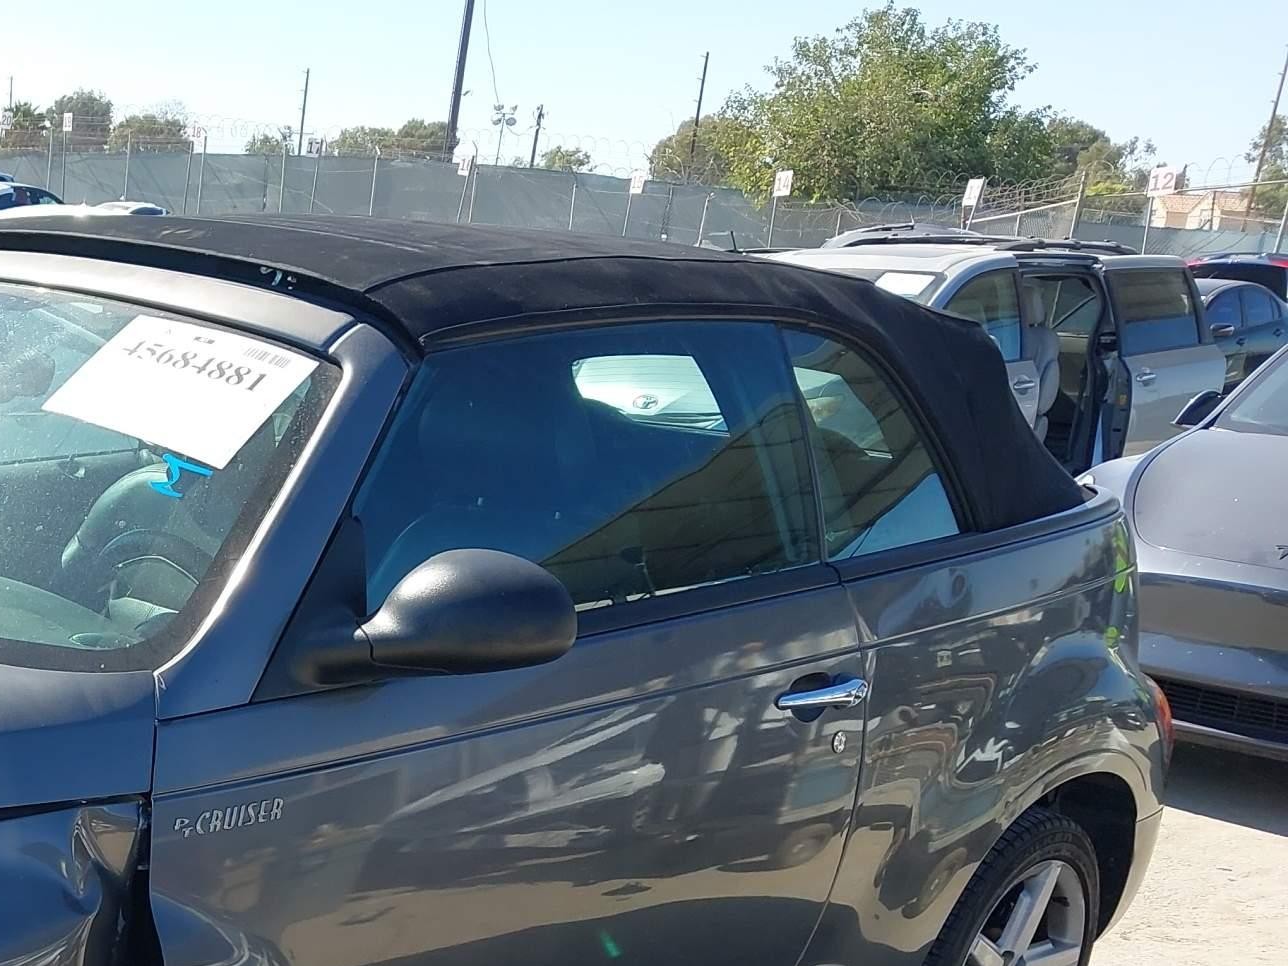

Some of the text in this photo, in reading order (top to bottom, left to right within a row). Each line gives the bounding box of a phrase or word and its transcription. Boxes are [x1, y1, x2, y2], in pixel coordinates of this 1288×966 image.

[2, 115, 12, 126] 20
[306, 141, 320, 154] 17
[776, 175, 789, 191] 14
[1150, 172, 1174, 191] 12
[122, 340, 268, 392] 45684881
[174, 798, 285, 838] PT CRUISER
